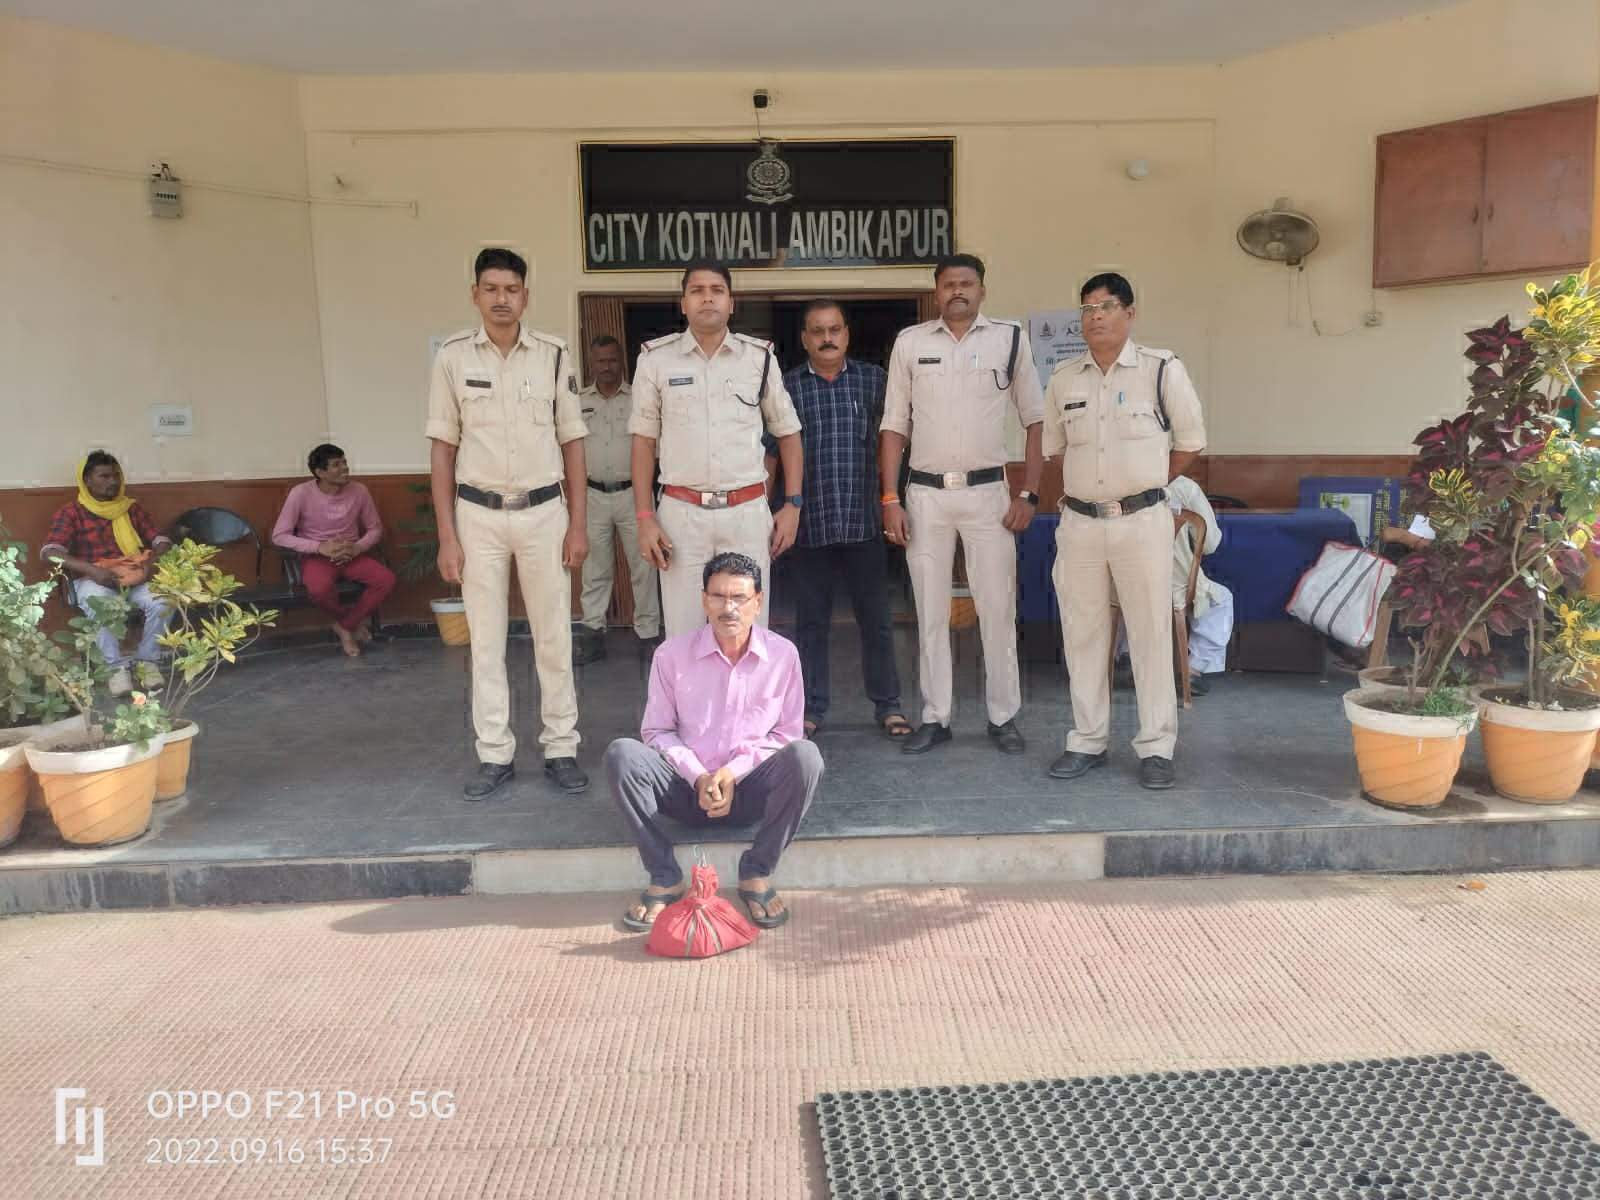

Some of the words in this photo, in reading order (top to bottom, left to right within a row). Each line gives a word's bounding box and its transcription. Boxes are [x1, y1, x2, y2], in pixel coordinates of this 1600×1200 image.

[588, 212, 649, 263] CITY
[658, 210, 777, 262] KOTWALI
[788, 208, 951, 259] AMBIKAPUR
